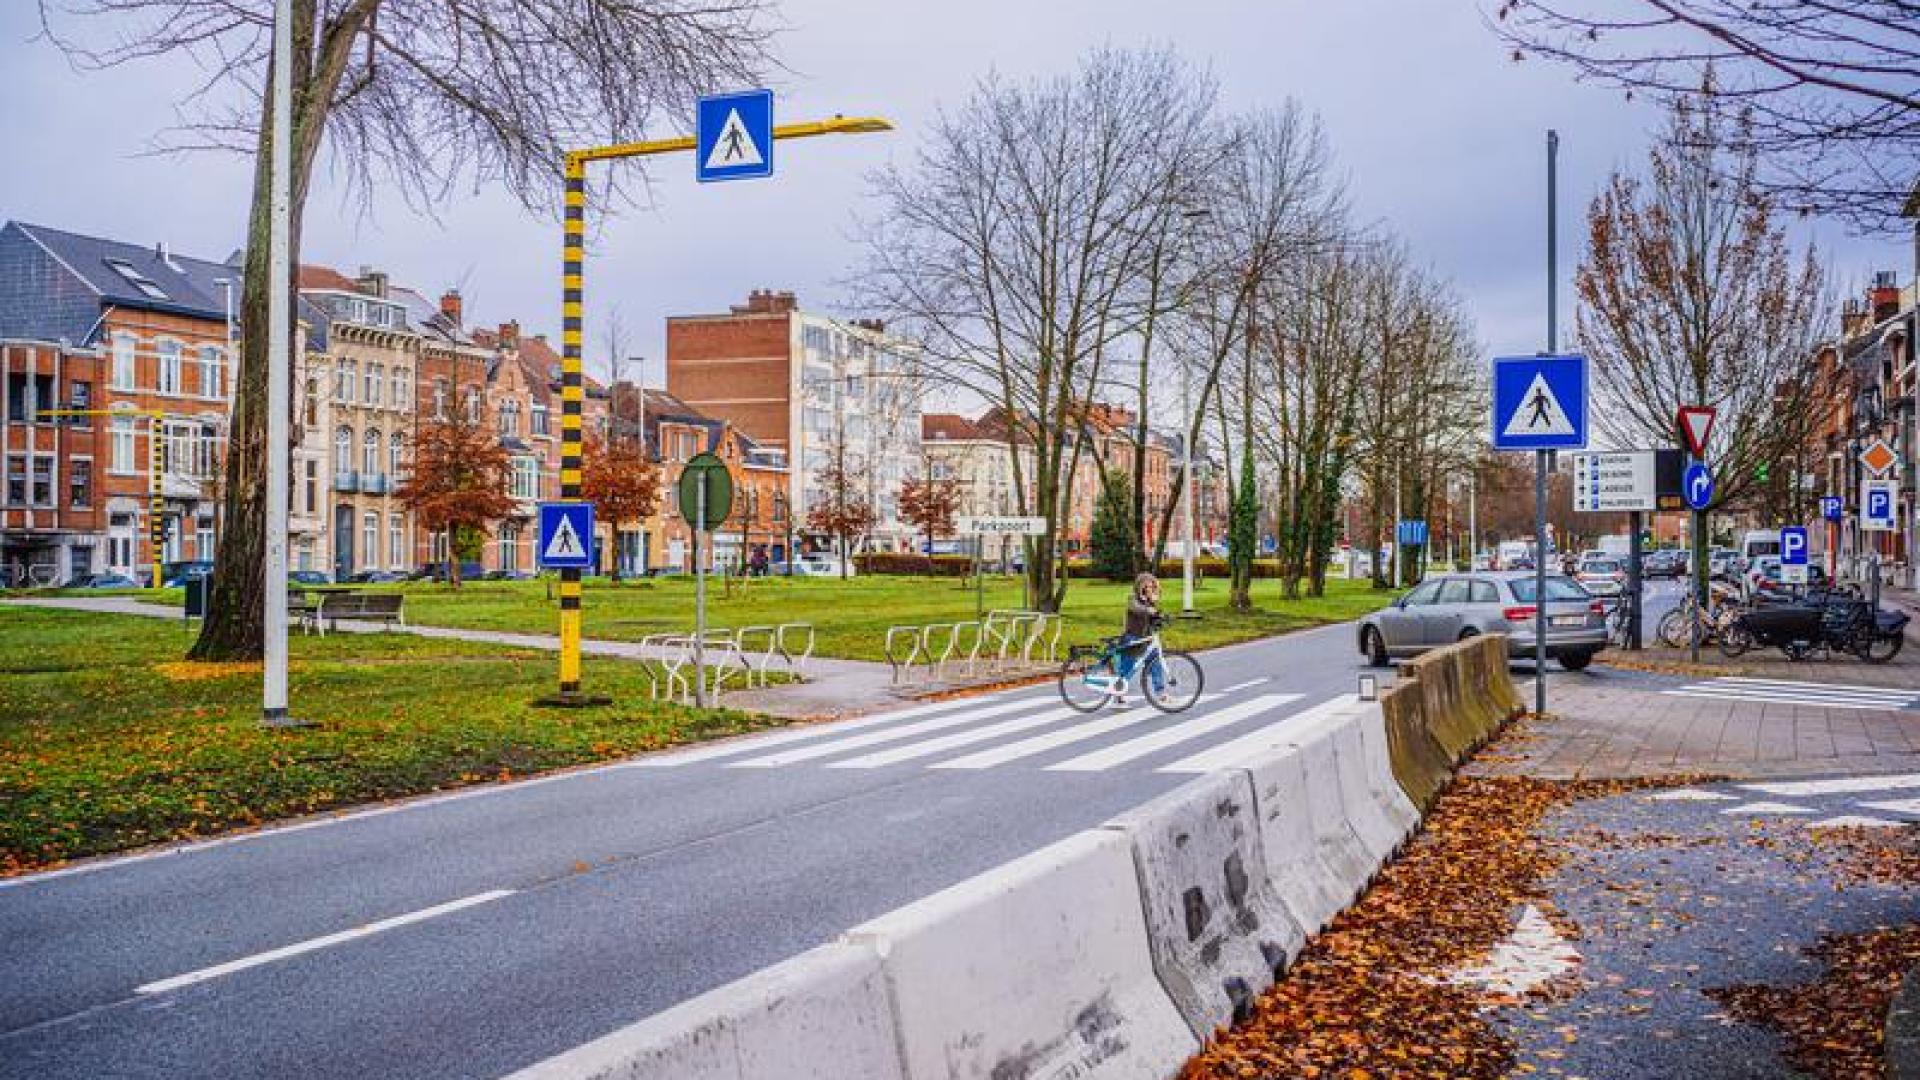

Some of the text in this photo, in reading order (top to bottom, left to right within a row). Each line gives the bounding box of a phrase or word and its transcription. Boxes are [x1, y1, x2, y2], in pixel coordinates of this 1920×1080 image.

[1872, 494, 1886, 514] P
[971, 520, 1030, 533] Parkpoort
[1785, 532, 1803, 560] P
